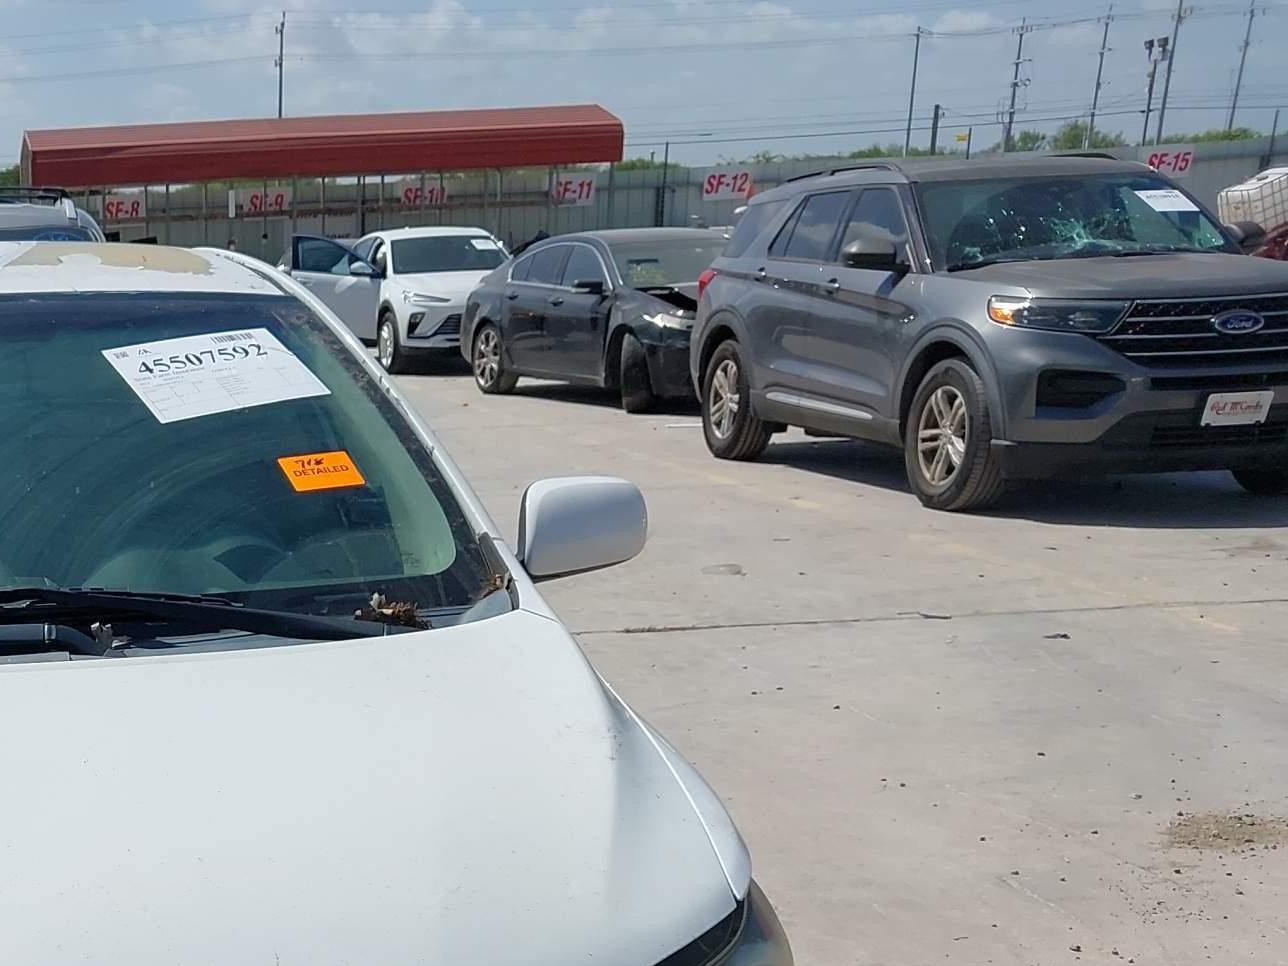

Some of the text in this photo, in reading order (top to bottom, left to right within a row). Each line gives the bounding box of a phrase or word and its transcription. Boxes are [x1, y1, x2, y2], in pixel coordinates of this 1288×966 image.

[1148, 151, 1192, 172] SF-15
[554, 180, 593, 200] SF-11
[705, 172, 749, 194] SF-12
[1227, 317, 1254, 328] Ford
[138, 343, 268, 374] 45507592
[293, 464, 350, 477] DETAILED
